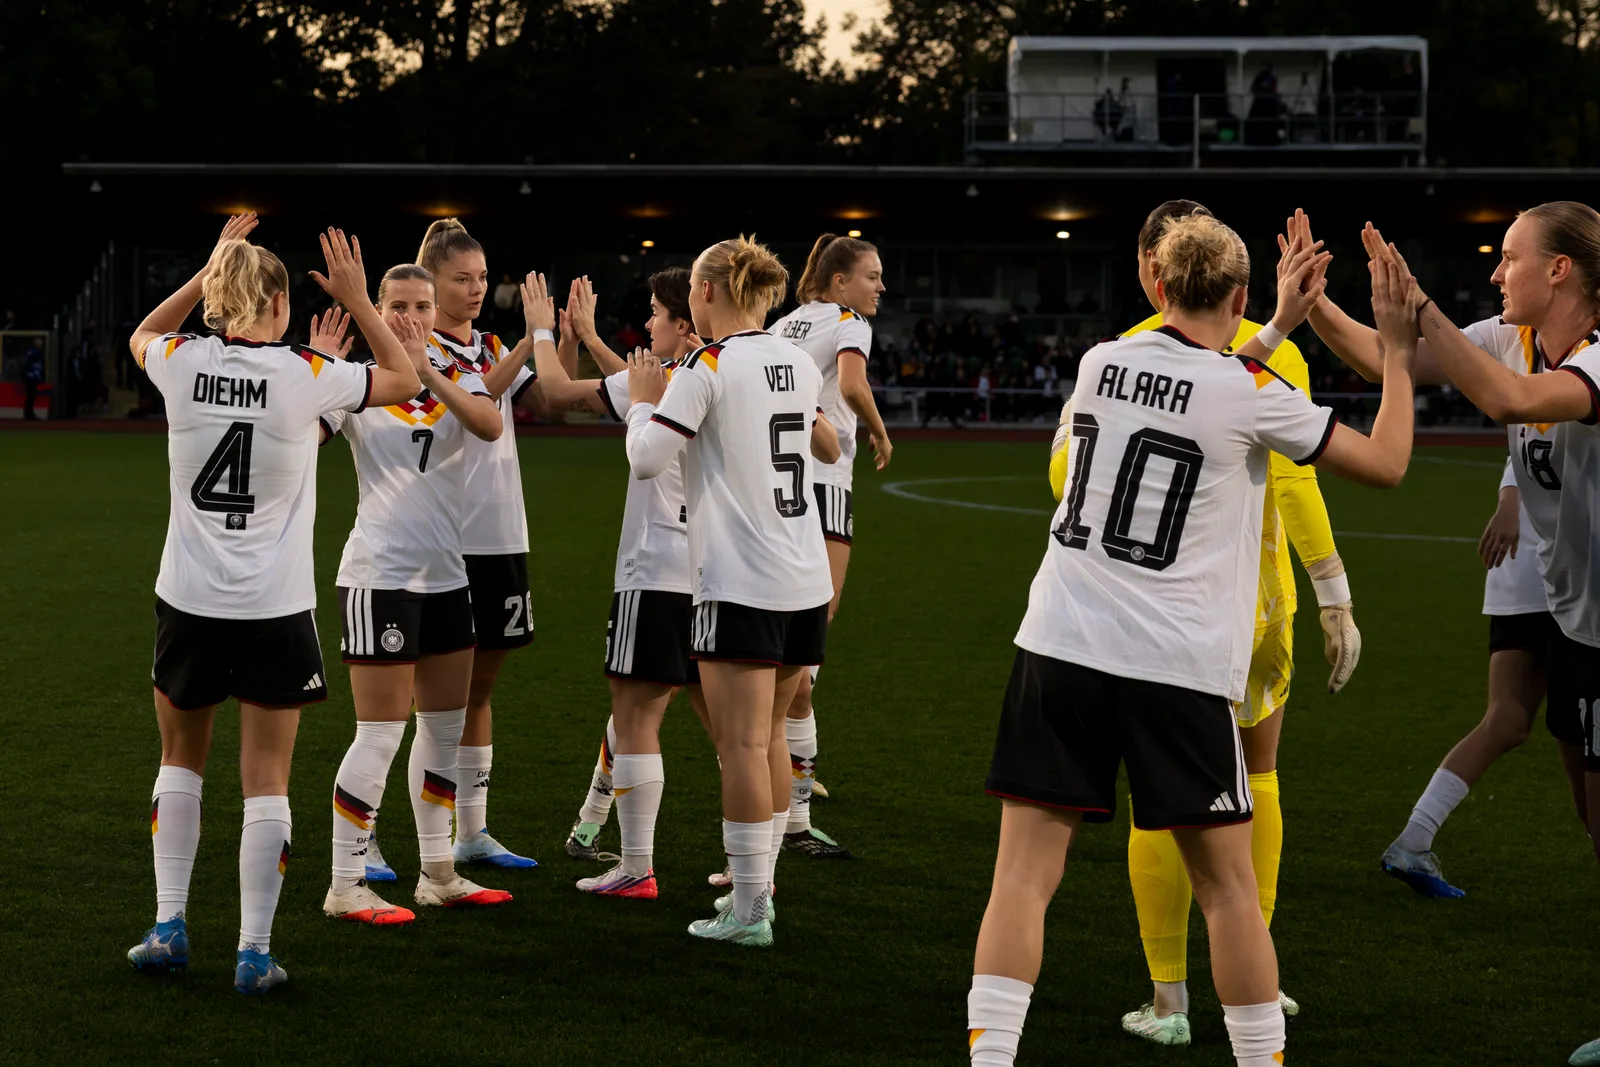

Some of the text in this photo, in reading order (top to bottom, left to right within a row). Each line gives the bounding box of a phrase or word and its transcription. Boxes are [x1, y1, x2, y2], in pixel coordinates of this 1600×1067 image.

[192, 372, 267, 409] DIEHM
[764, 364, 795, 392] VEIT
[1096, 364, 1194, 414] ALARA
[411, 428, 434, 473] 7
[769, 412, 808, 518] 5
[190, 421, 255, 530] 4
[1051, 412, 1205, 571] 10
[476, 770, 490, 778] DF
